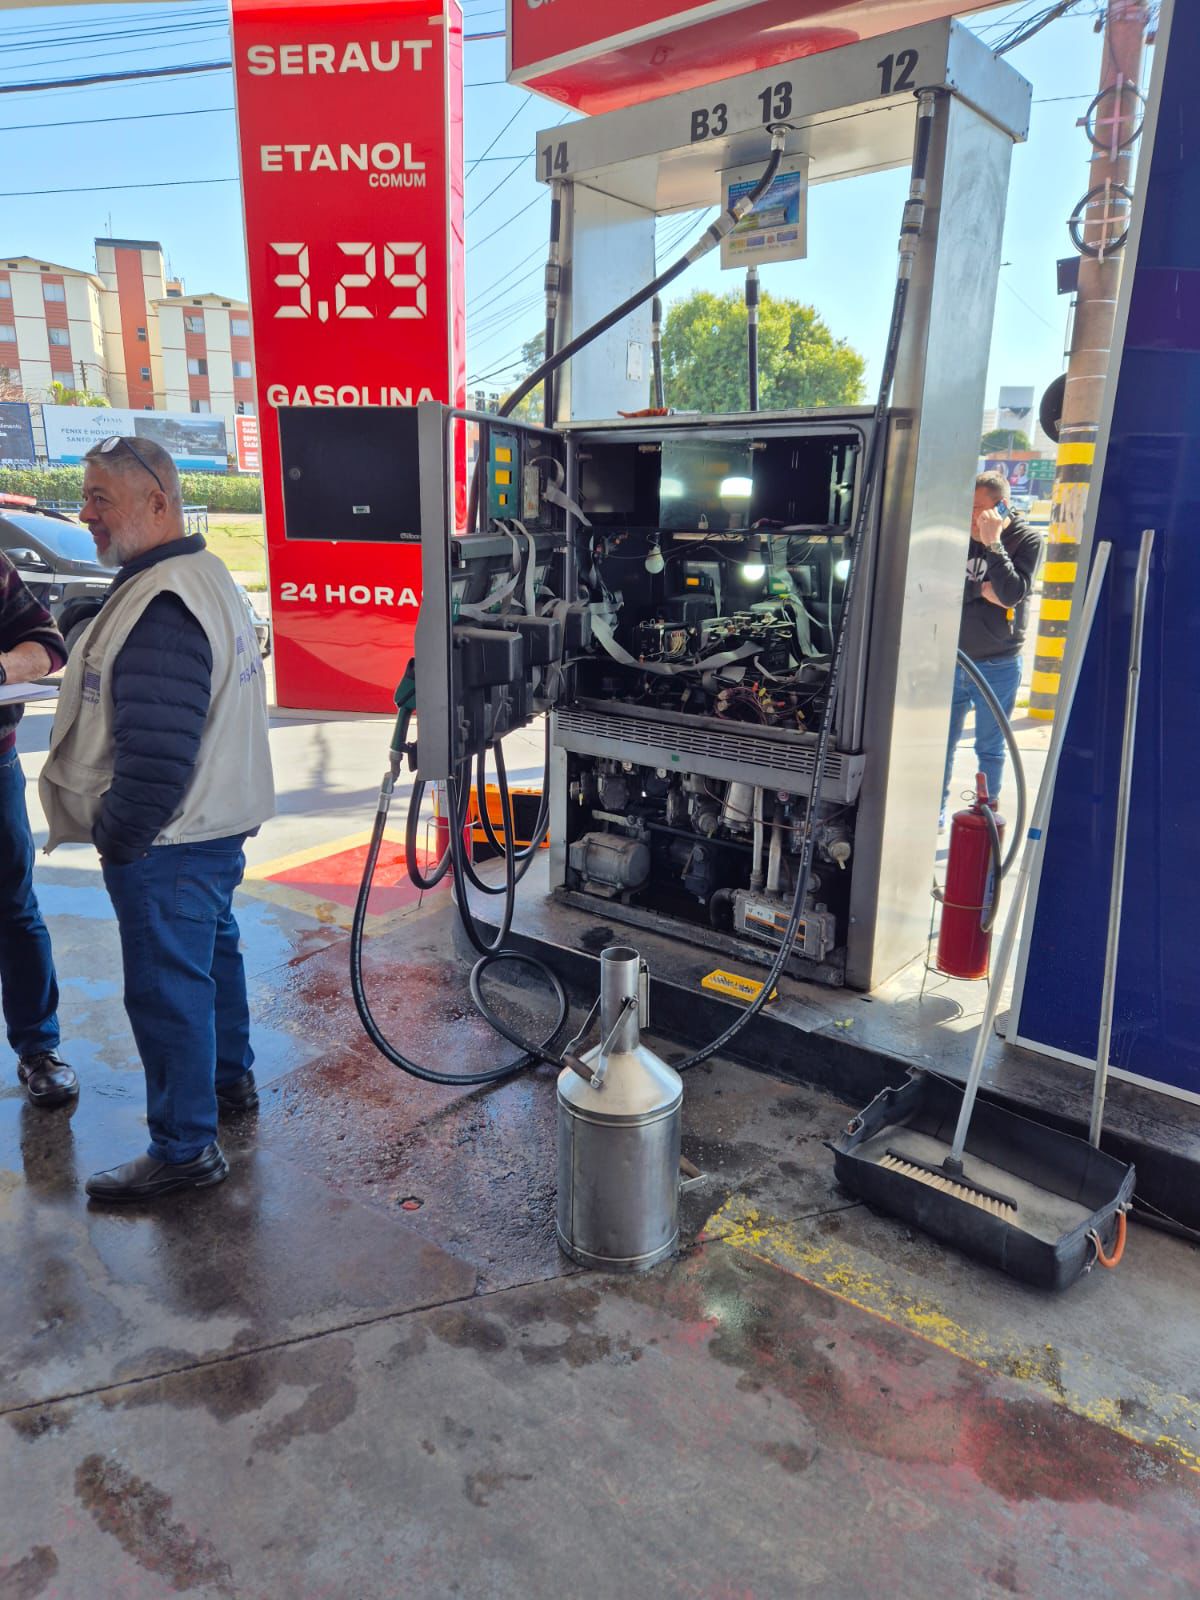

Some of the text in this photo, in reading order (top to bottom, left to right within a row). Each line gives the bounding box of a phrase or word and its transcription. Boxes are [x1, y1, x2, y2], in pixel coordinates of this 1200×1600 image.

[247, 39, 433, 76] SERAUT
[877, 48, 919, 95] 12
[758, 81, 793, 123] 13
[690, 103, 728, 144] B3
[260, 142, 426, 172] ETANOL
[542, 141, 569, 178] 14
[368, 173, 426, 188] COMUM
[268, 241, 427, 324] 3,29
[280, 581, 424, 607] 24 HORA
